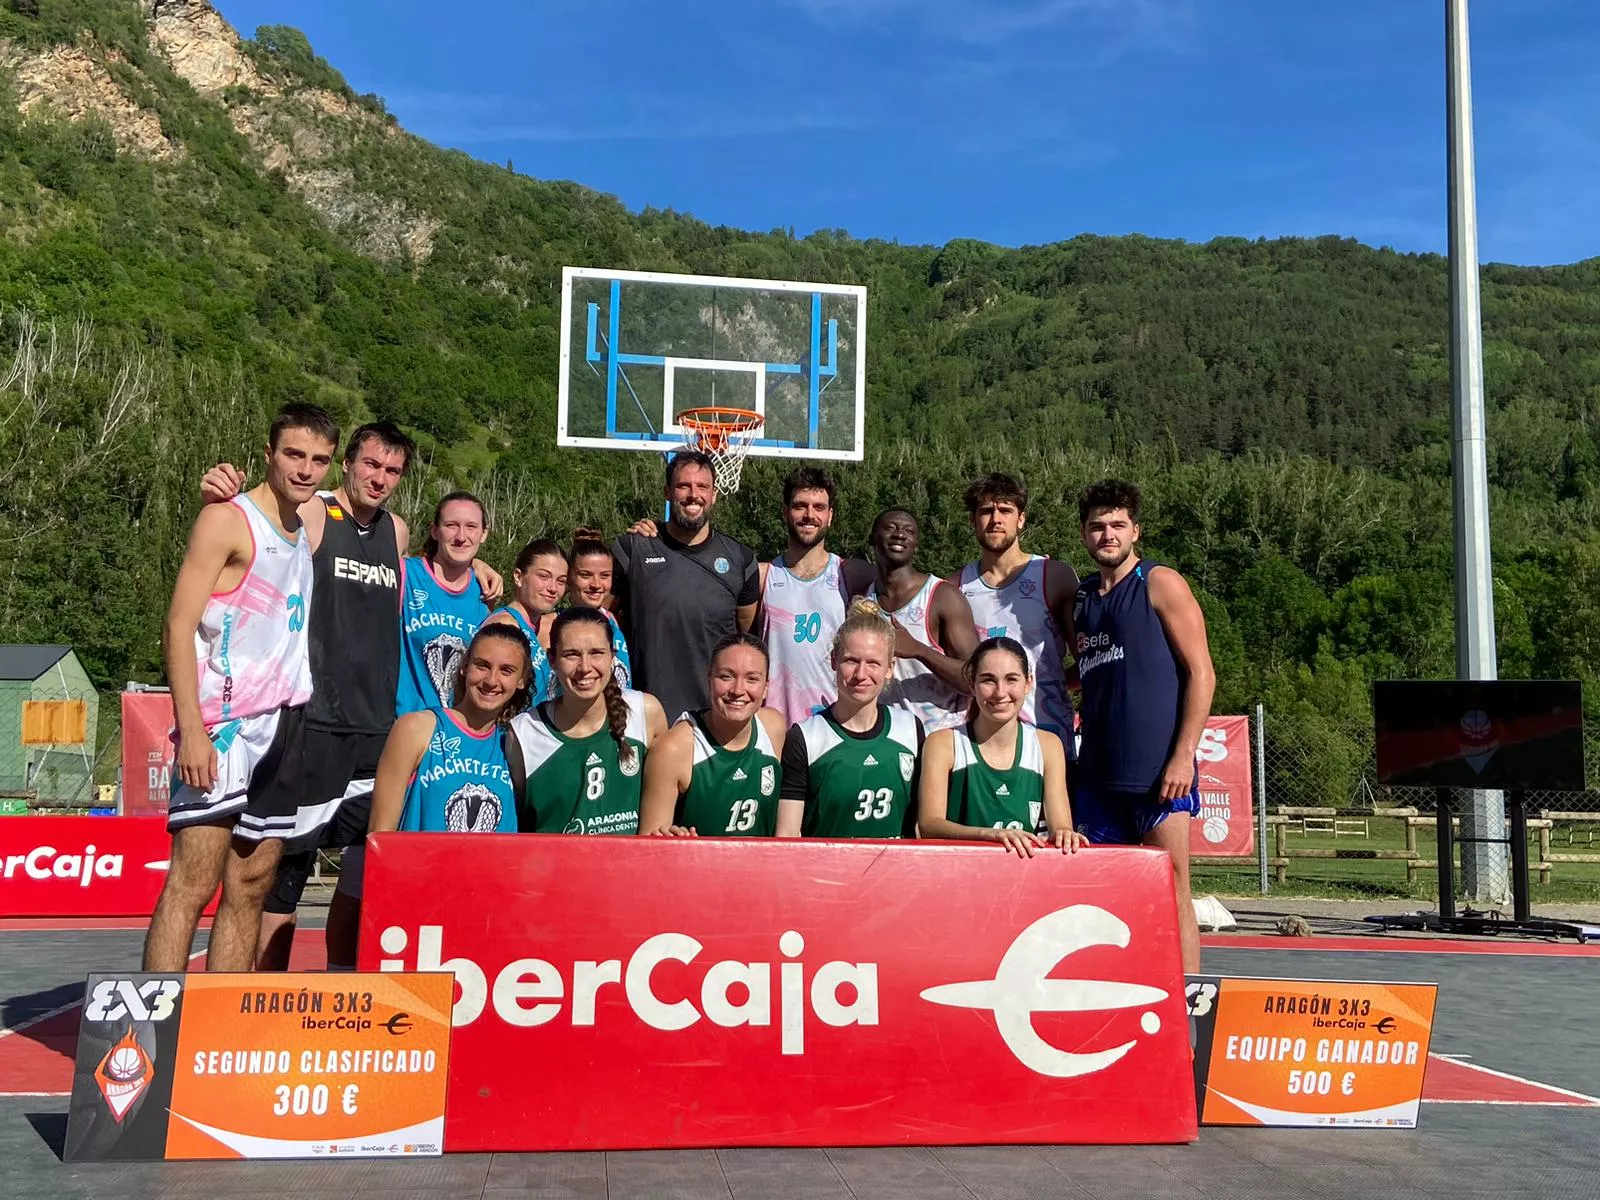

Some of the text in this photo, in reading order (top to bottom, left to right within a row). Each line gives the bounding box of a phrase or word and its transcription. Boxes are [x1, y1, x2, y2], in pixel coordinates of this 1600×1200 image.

[334, 557, 397, 589] ESPAÑA
[794, 612, 822, 643] 30
[420, 758, 490, 788] MACHETE
[587, 767, 605, 800] 8
[854, 787, 894, 821] 33
[1204, 793, 1231, 805] VALLE
[587, 810, 638, 827] ARAGONIA
[725, 798, 759, 832] 13
[240, 987, 374, 1014] ARAGÓN 3X3
[1264, 993, 1372, 1016] ARAGÓN 3X3
[301, 1015, 372, 1034] iberCaja
[1312, 1018, 1366, 1032] iberCaja
[193, 1049, 436, 1075] SEGUNDO CLASIFICADO
[1225, 1036, 1420, 1065] EQUIPO GANADOR
[1287, 1070, 1357, 1095] 500 €
[273, 1084, 360, 1116] 300 €
